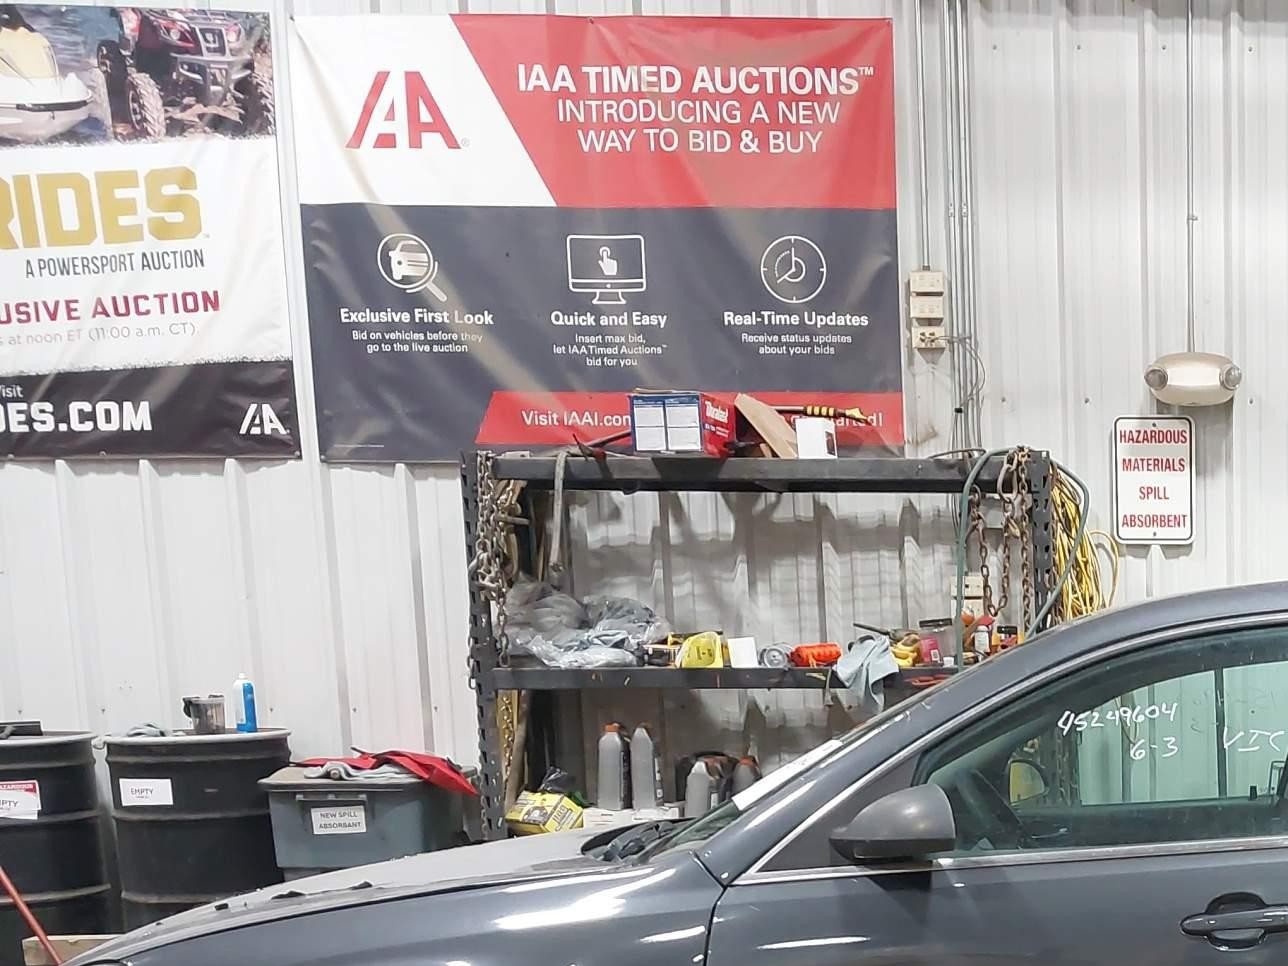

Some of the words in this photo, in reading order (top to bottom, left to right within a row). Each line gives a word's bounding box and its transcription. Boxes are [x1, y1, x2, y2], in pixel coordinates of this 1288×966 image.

[518, 64, 576, 92] IAA
[582, 65, 683, 94] TIMED
[558, 99, 741, 124] INTRODUCING
[750, 101, 770, 124] A
[778, 101, 841, 124] NEW
[577, 129, 637, 151] WAY
[643, 128, 679, 152] TO
[688, 129, 732, 153] BID
[739, 129, 761, 154] &
[769, 130, 823, 153] BUY
[25, 259, 35, 278] A
[38, 252, 135, 277] POWERSPORT
[141, 248, 205, 271] AUCTION
[91, 290, 220, 319] AUCTION
[340, 308, 411, 323] Exclusive
[414, 308, 449, 323] First
[454, 310, 494, 325] Look
[550, 310, 596, 326] Quick
[599, 312, 628, 326] and
[632, 312, 667, 328] Easy
[723, 311, 800, 326] Real-Time
[804, 311, 869, 328] Updates
[8, 334, 22, 346] at
[26, 332, 63, 345] noon
[67, 329, 82, 341] ET
[352, 330, 368, 340] Bid
[369, 332, 382, 341] on
[384, 331, 425, 341] vehicles
[427, 331, 458, 341] before
[461, 332, 484, 343] they
[575, 333, 602, 343] Insert
[605, 334, 626, 343] max
[628, 333, 646, 344] bid,
[741, 333, 779, 343] Receive
[781, 333, 810, 343] status
[812, 334, 852, 344] updates
[367, 344, 379, 354] go
[381, 343, 392, 352] to
[393, 343, 410, 352] the
[412, 343, 430, 352] live
[432, 343, 468, 353] auction
[553, 344, 566, 354] let
[568, 344, 587, 354] IAA
[588, 345, 618, 354] Timed
[759, 345, 787, 354] about
[789, 346, 811, 356] your
[814, 345, 835, 355] bids
[586, 357, 601, 366] bid
[603, 356, 617, 366] for
[620, 358, 638, 368] you
[0, 400, 153, 433] ES.COM
[521, 410, 560, 426] Visit
[1119, 429, 1188, 444] HAZARDOUS
[1122, 458, 1185, 472] MATERIALS
[1139, 486, 1170, 500] SPILL
[1122, 514, 1188, 528] ABSORBENT
[1057, 702, 1178, 737] 45249604
[1129, 736, 1178, 761] 6-3
[130, 787, 154, 796] EMPTY
[0, 799, 18, 808] PTY
